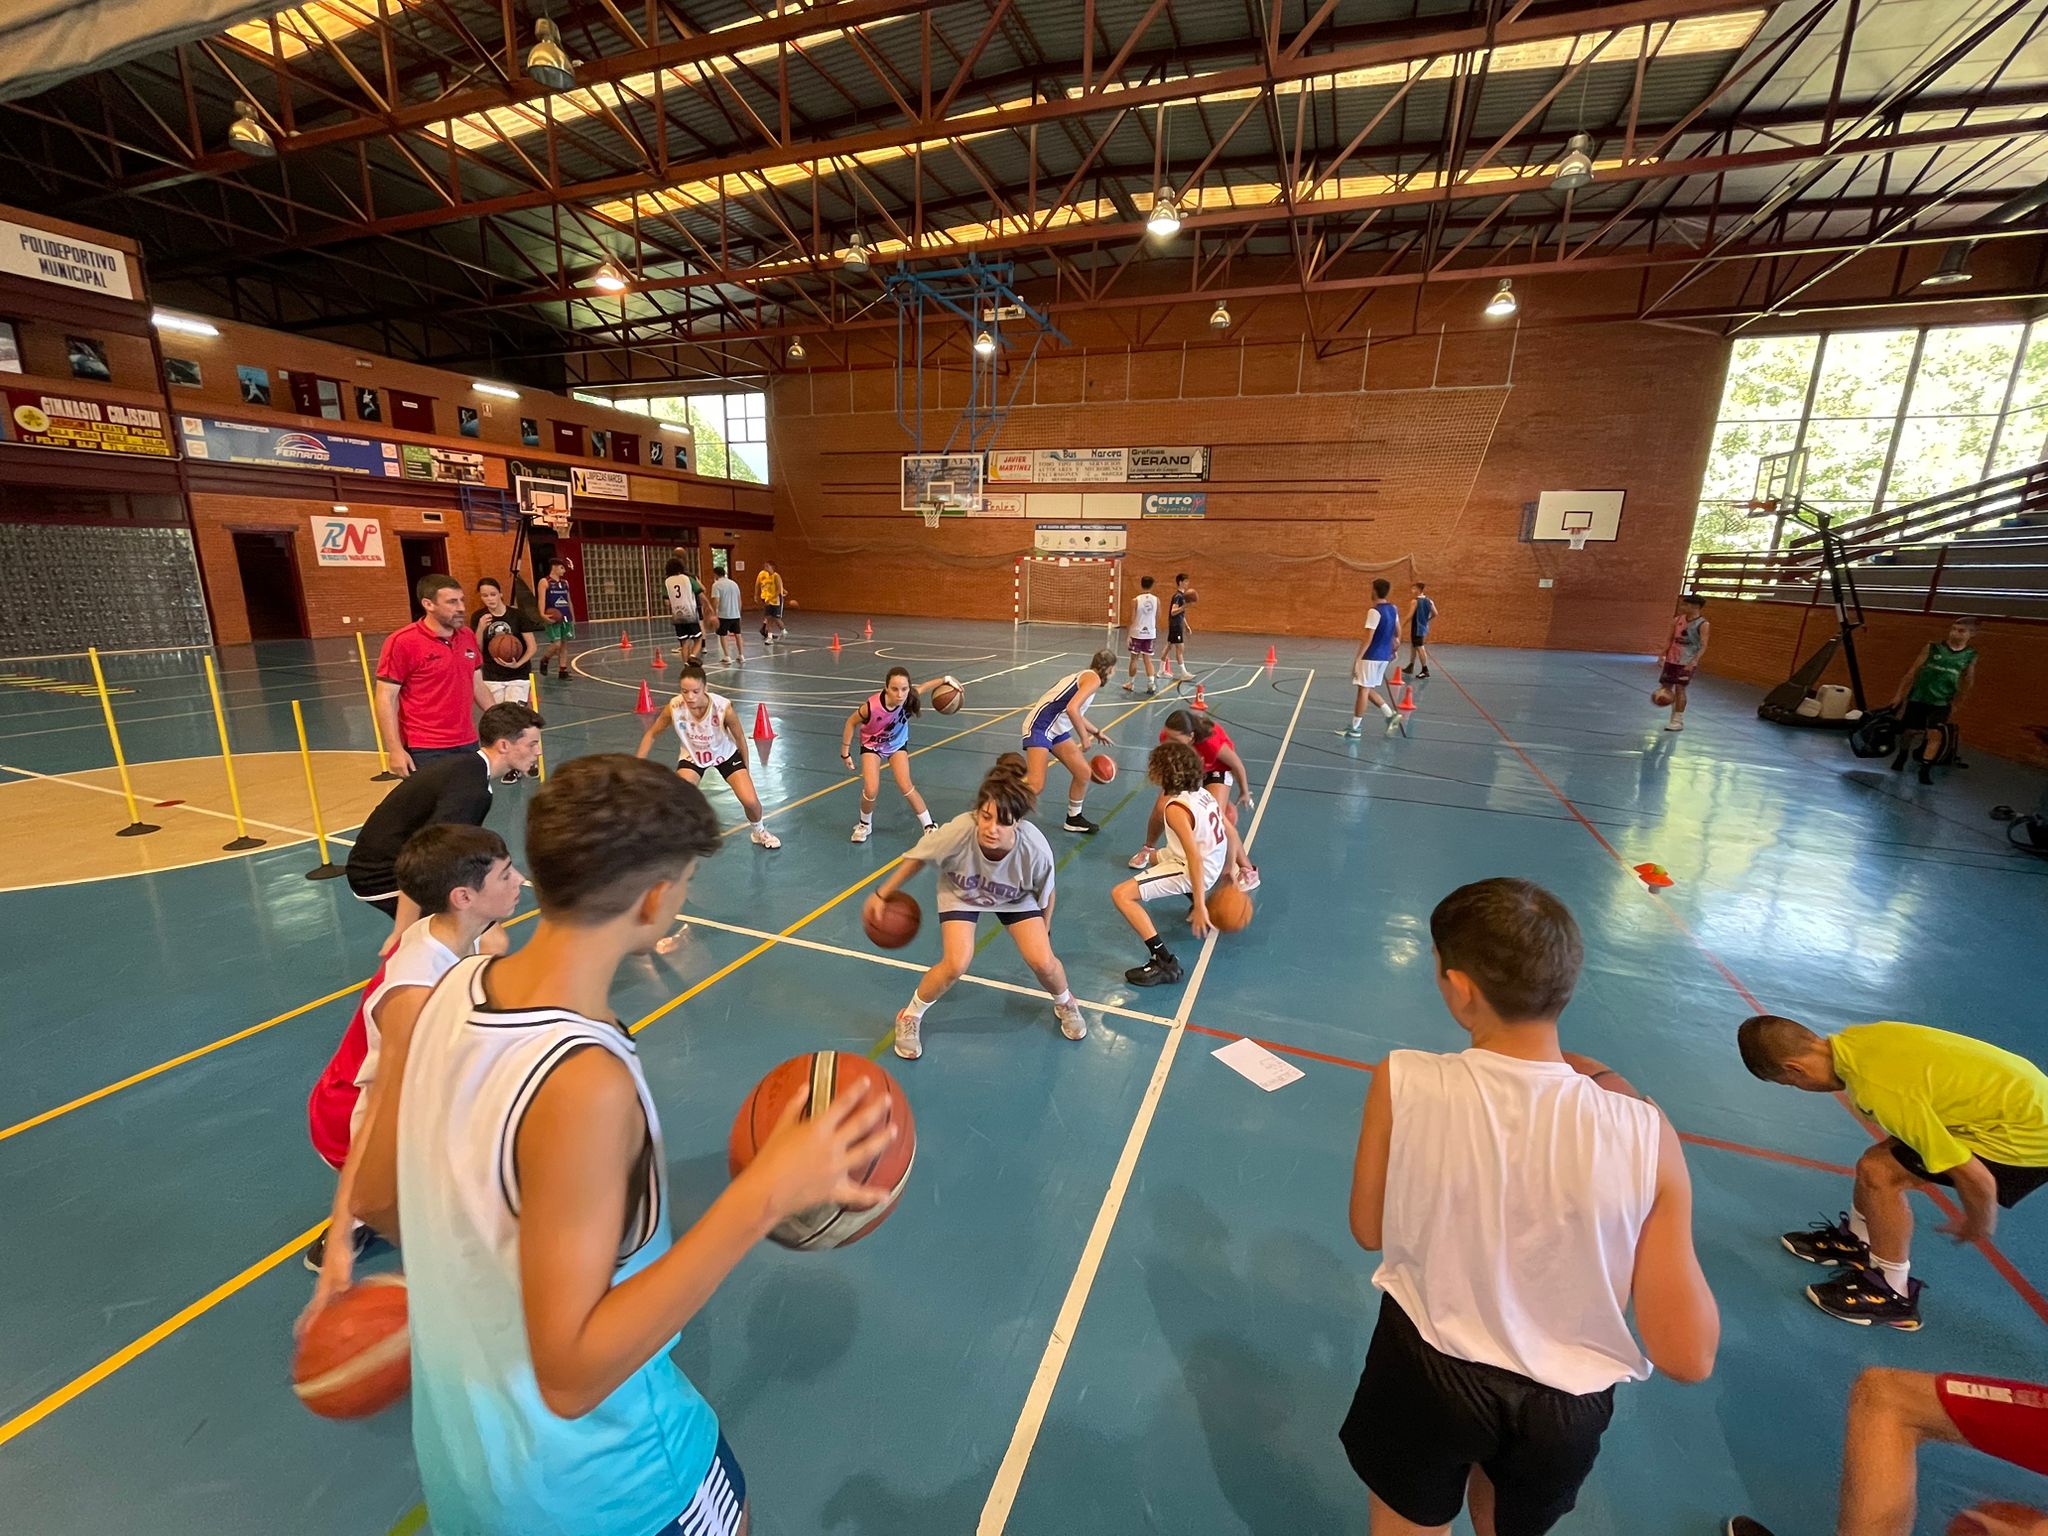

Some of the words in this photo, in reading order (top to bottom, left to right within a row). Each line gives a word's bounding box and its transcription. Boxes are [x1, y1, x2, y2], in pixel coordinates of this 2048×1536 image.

[19, 232, 117, 272] POLIDEPORTIVO
[38, 257, 108, 288] MUNICIPAL
[303, 394, 310, 407] 2
[40, 396, 102, 421] GIMNASIO
[106, 405, 162, 429] COLISEUM
[623, 447, 629, 457] 1
[1063, 449, 1077, 459] Bus
[1004, 455, 1027, 464] JAVIER
[1132, 456, 1190, 466] VERANO
[1146, 494, 1193, 513] Carro
[673, 584, 682, 599] 3
[695, 751, 713, 765] 10
